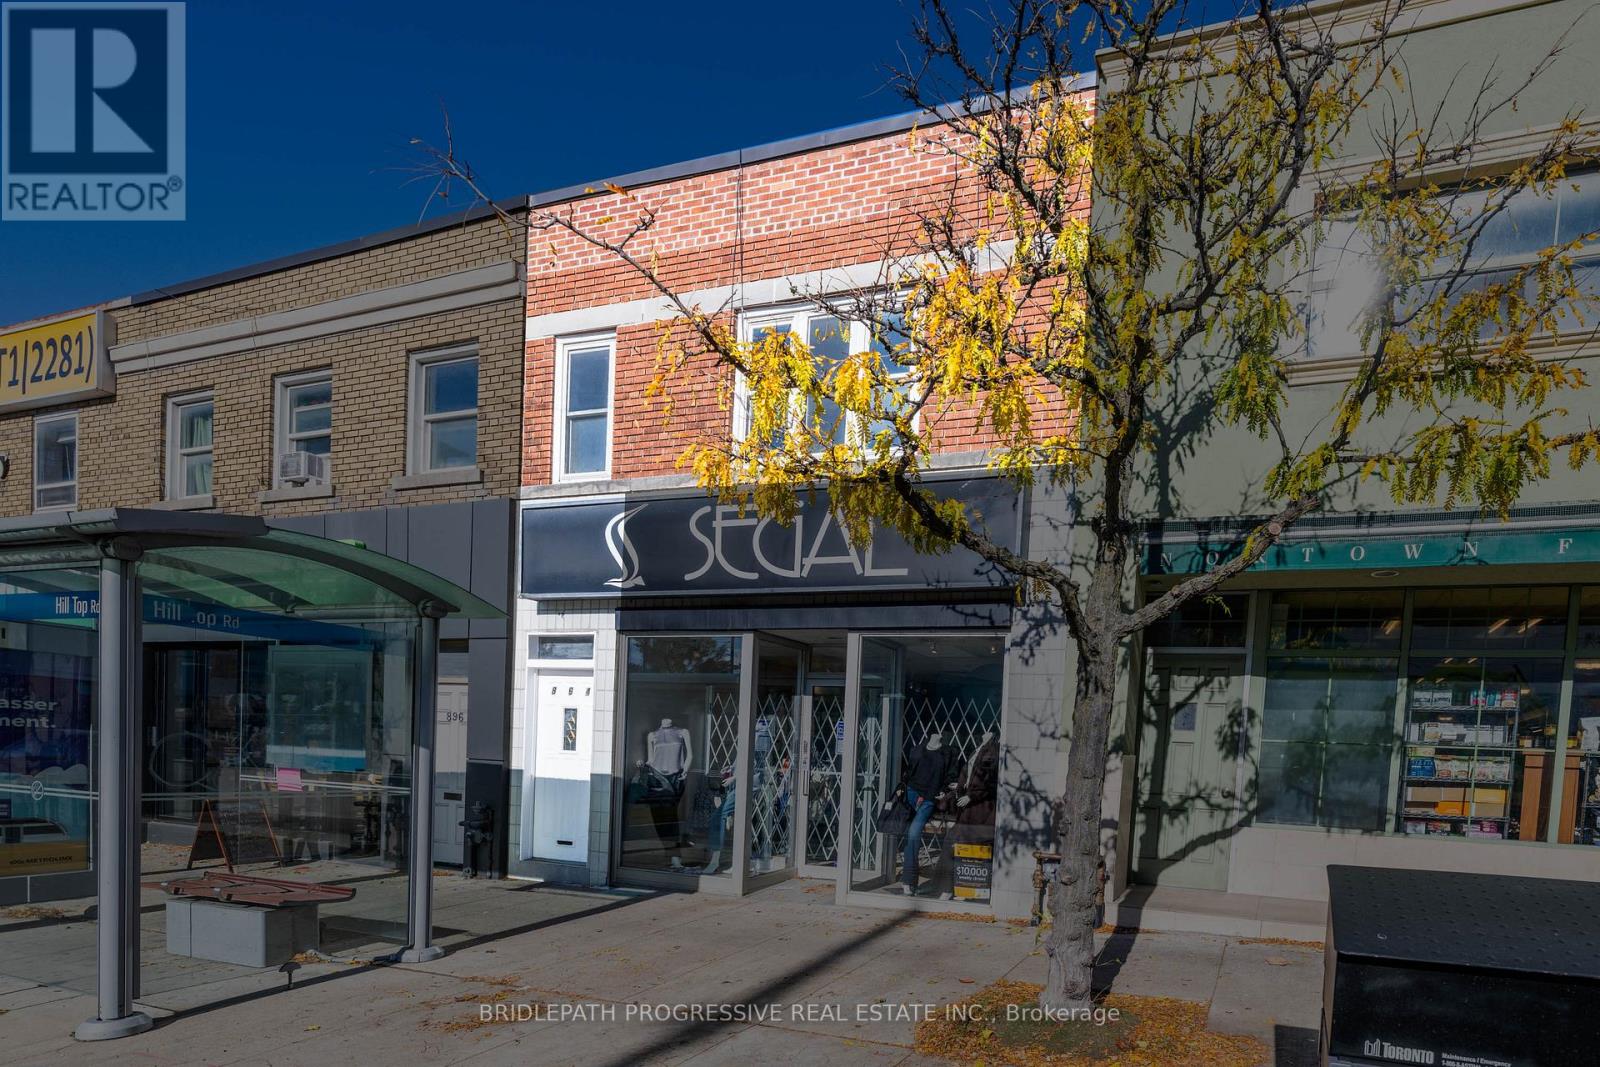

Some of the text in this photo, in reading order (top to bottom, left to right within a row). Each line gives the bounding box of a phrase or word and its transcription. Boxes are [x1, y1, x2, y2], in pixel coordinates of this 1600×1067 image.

[684, 499, 909, 583] SEGAL
[1161, 541, 1480, 567] NOTOWN
[55, 596, 70, 614] Hill
[72, 596, 88, 617] Top
[153, 600, 240, 629] Hill op Rd
[446, 711, 464, 722] 896
